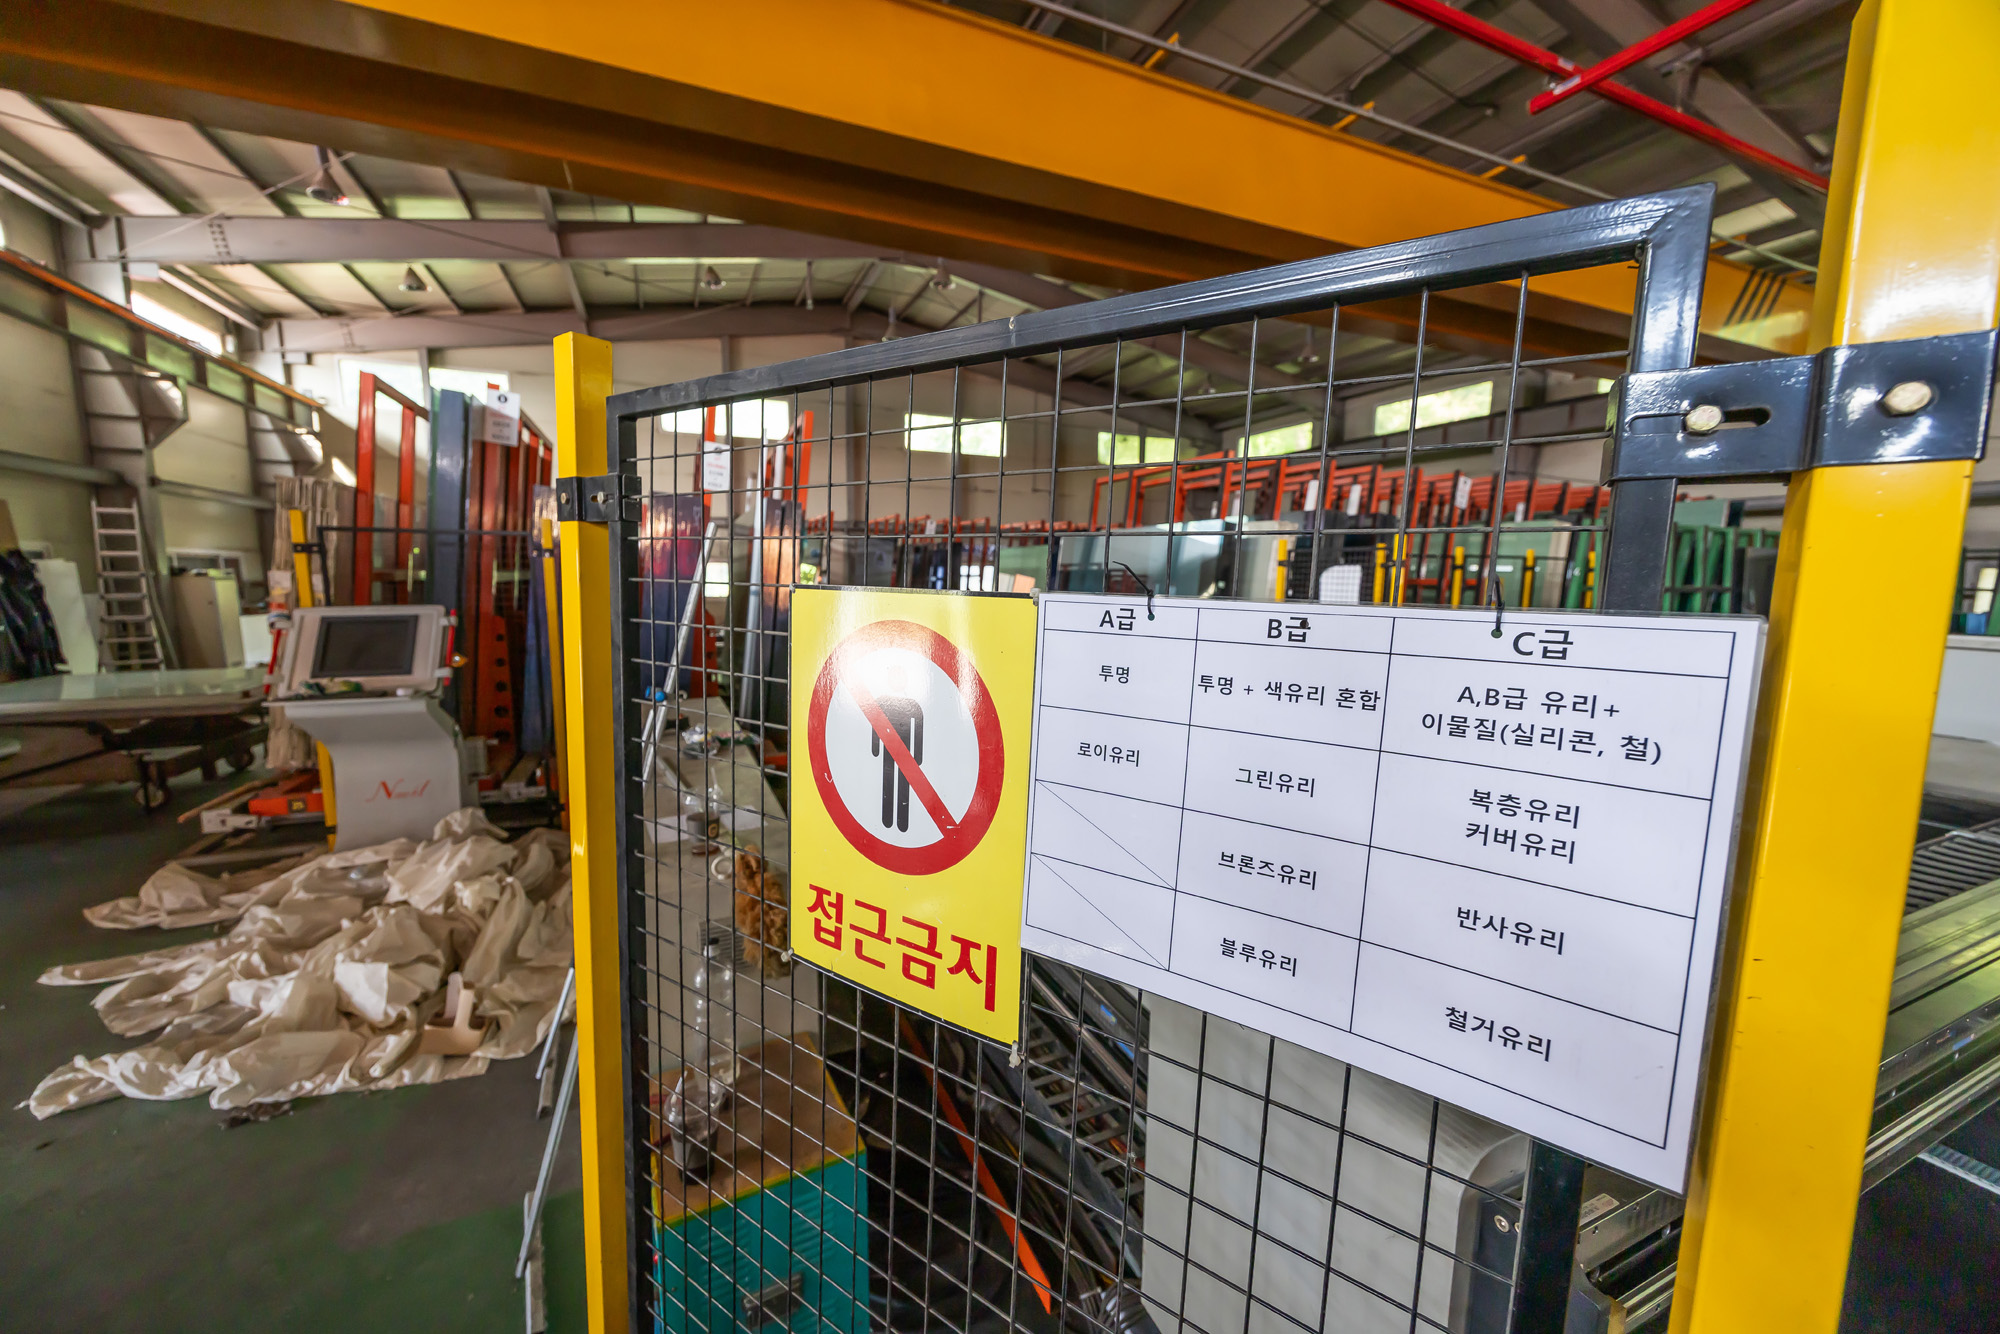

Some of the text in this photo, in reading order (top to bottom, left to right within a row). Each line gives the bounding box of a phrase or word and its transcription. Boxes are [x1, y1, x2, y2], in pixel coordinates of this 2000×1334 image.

[1098, 607, 1137, 632] A급
[1267, 616, 1312, 643] B급
[1511, 630, 1575, 661] C급
[1098, 665, 1131, 684] 투명
[1197, 674, 1234, 696] 투명
[1264, 681, 1325, 706] 색유리
[1335, 687, 1381, 712] 혼합
[1456, 686, 1529, 711] A,B급
[1077, 742, 1140, 768] 로이유리
[1421, 713, 1662, 766] 이물질(실리콘, 철)
[1235, 768, 1315, 798] 그린유리
[1468, 788, 1580, 829] 복층유리
[1465, 822, 1577, 864] 커버유리
[1218, 851, 1317, 891] 브론즈유리
[807, 883, 998, 1013] 접근금지
[1457, 906, 1565, 956] 반사유리
[1219, 937, 1297, 978] 블루유리
[1444, 1006, 1552, 1063] 철거유리
